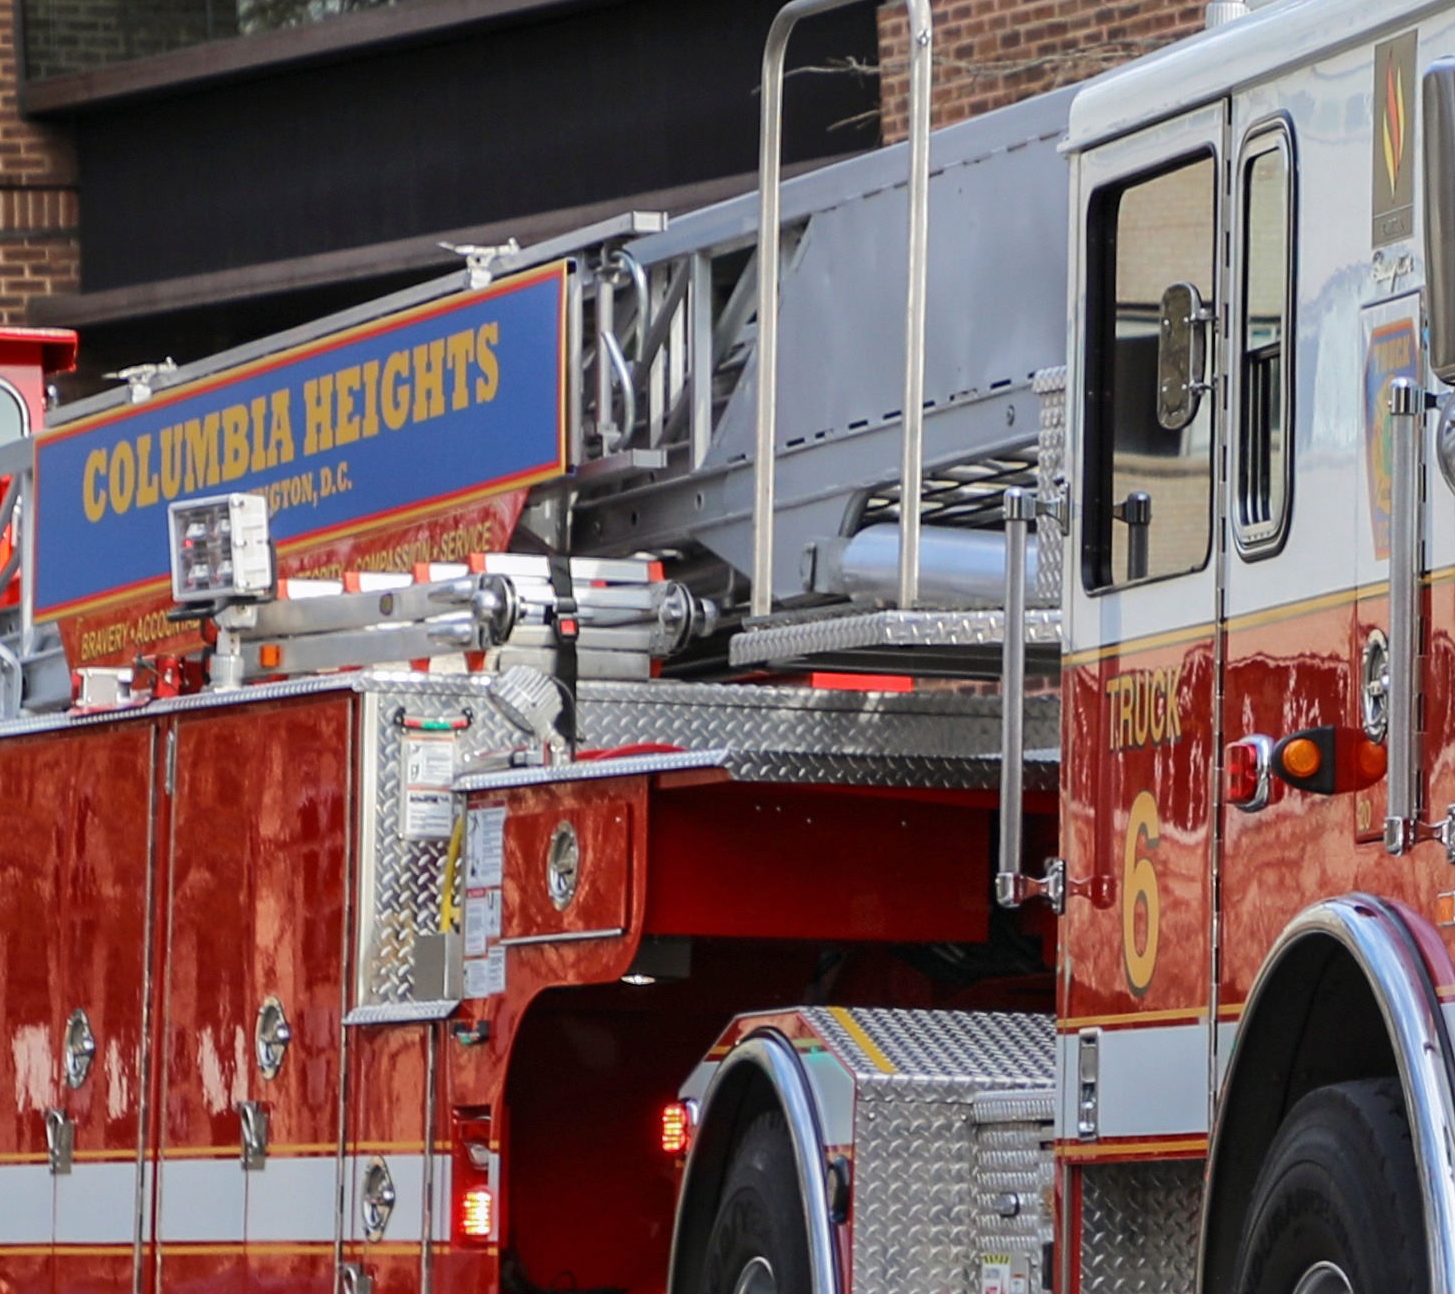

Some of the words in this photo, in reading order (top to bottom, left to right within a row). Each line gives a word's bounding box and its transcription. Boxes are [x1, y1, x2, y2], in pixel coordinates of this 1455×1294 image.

[83, 389, 295, 523] COLUMBIA
[303, 321, 500, 456] HEIGHTS
[319, 460, 353, 498] D.C.
[81, 621, 130, 662] BRAVERY
[441, 520, 492, 561] SERVICE
[1106, 664, 1183, 753] TRUCK
[1122, 788, 1161, 998] 6
